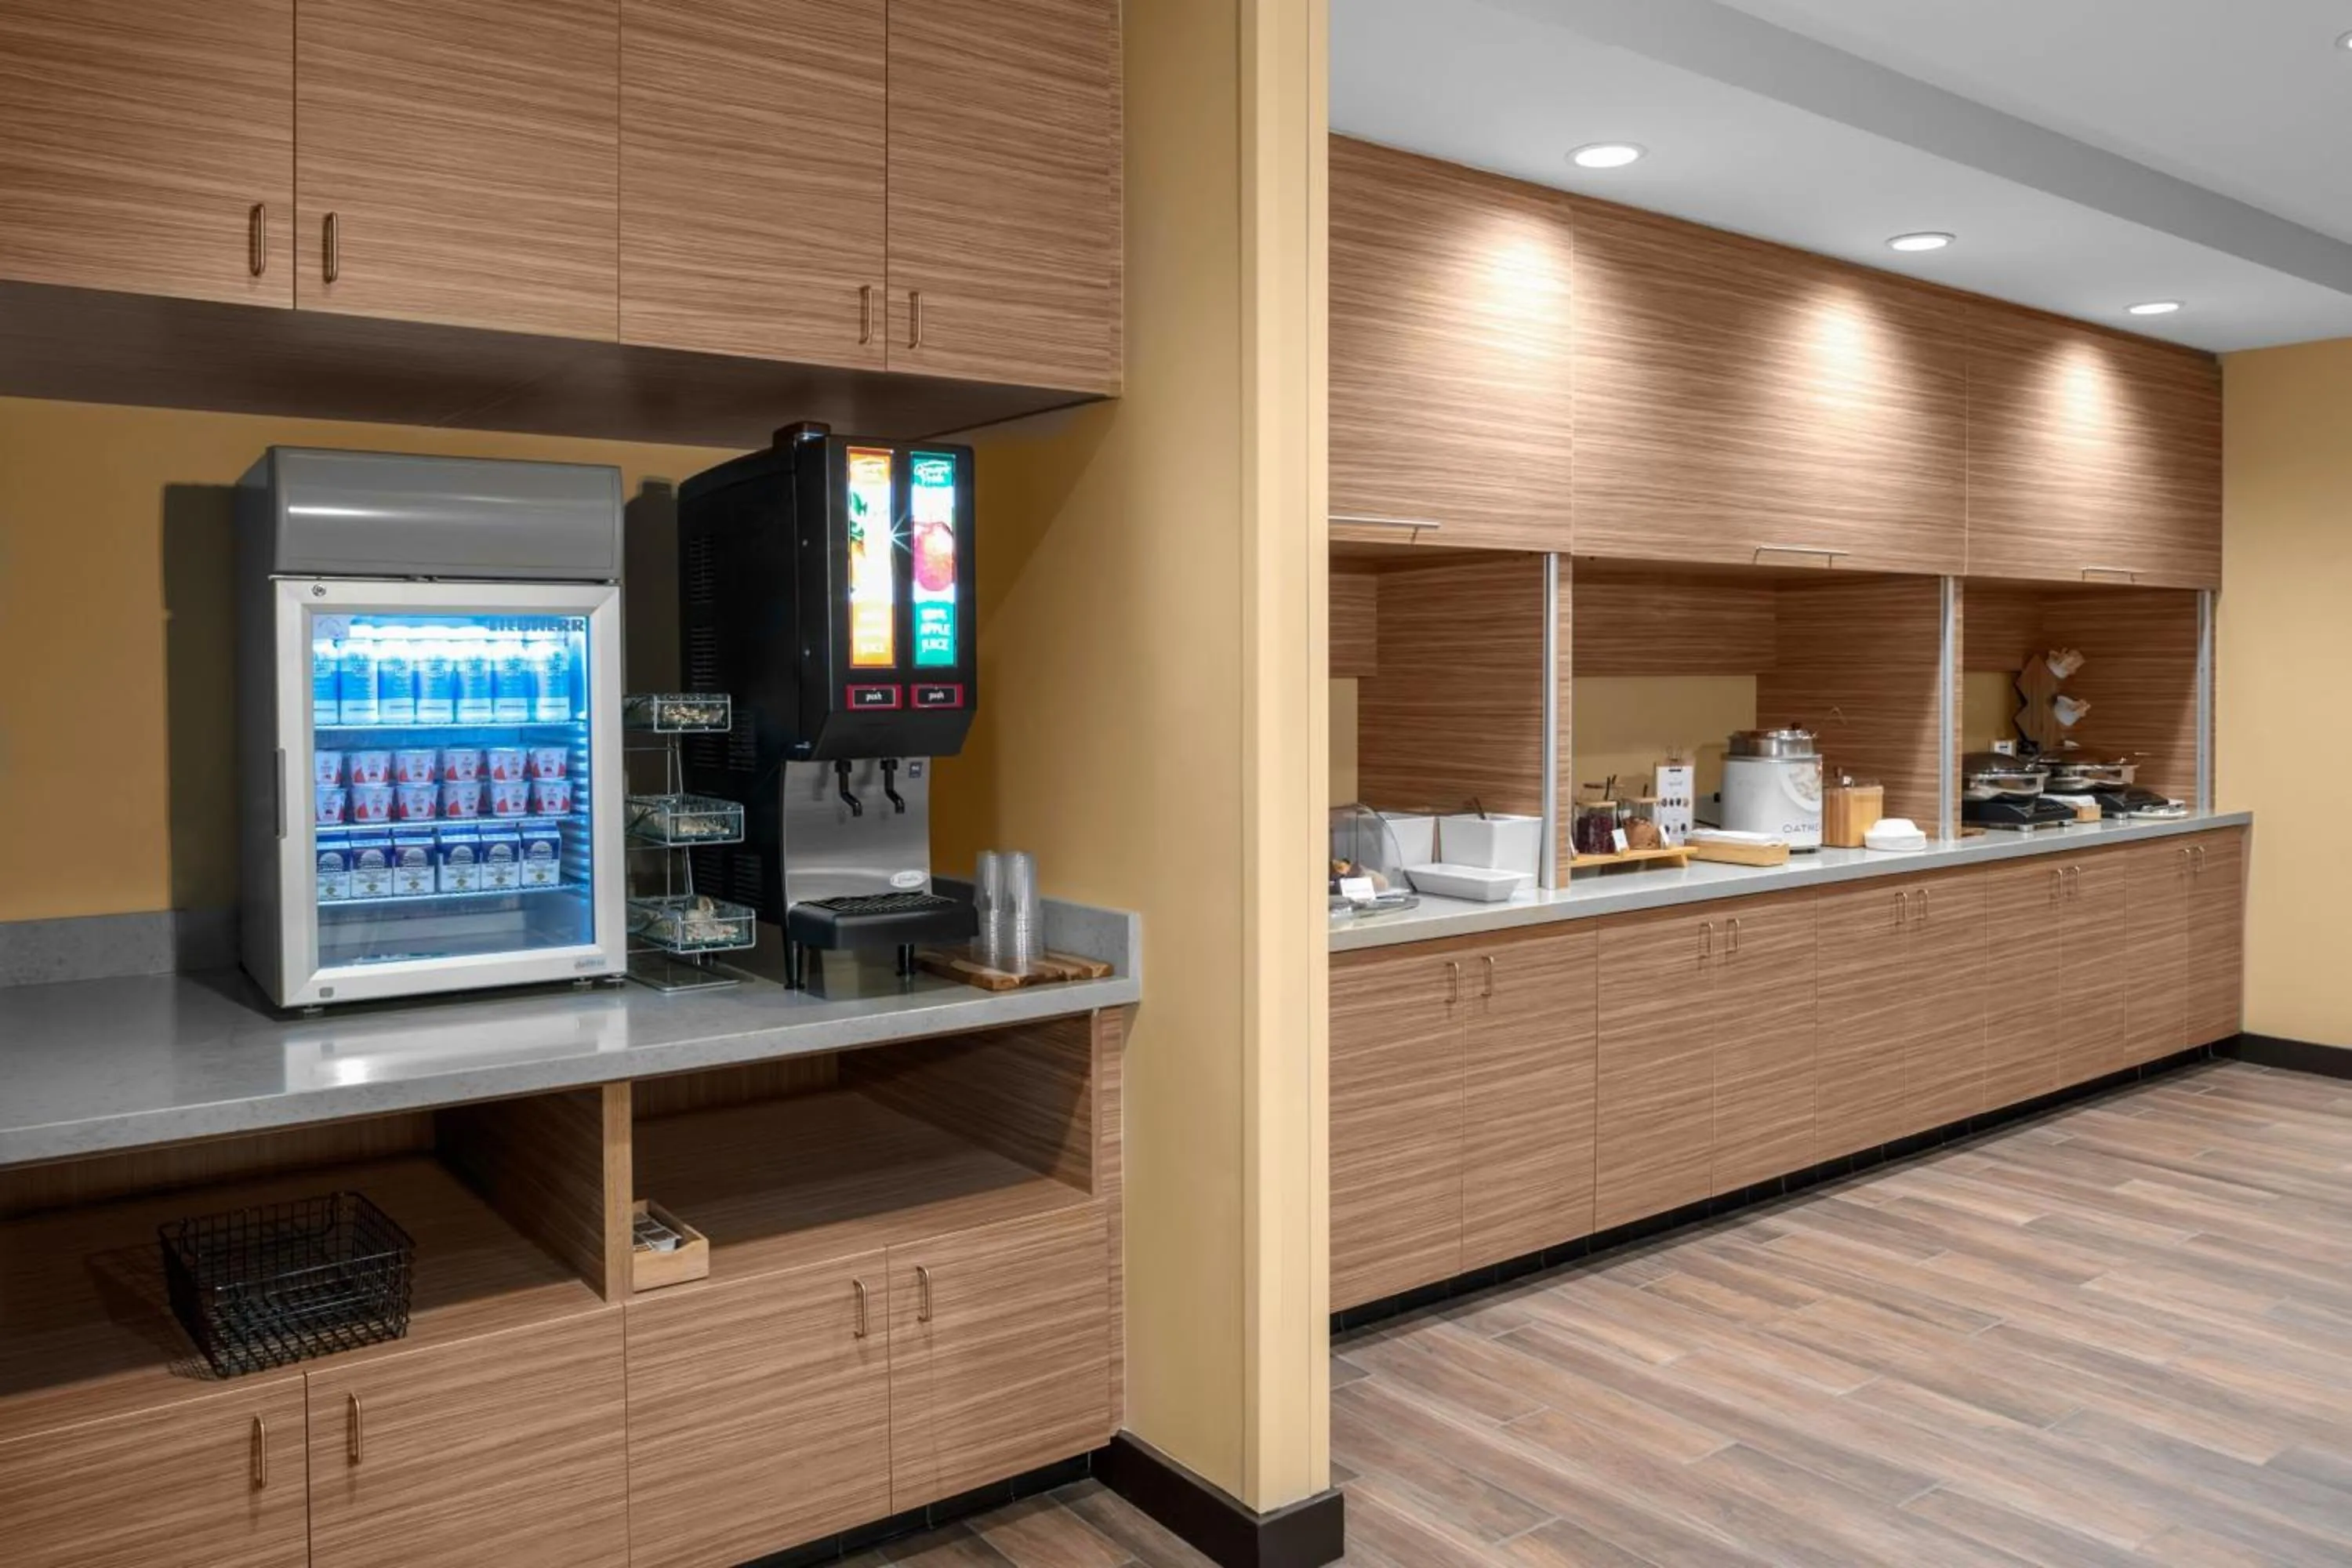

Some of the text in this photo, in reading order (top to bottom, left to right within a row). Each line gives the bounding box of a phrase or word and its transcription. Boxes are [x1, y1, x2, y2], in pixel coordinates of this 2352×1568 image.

[920, 622, 951, 636] APPLE
[921, 637, 949, 653] JUICE
[866, 691, 882, 702] push
[928, 691, 944, 701] push
